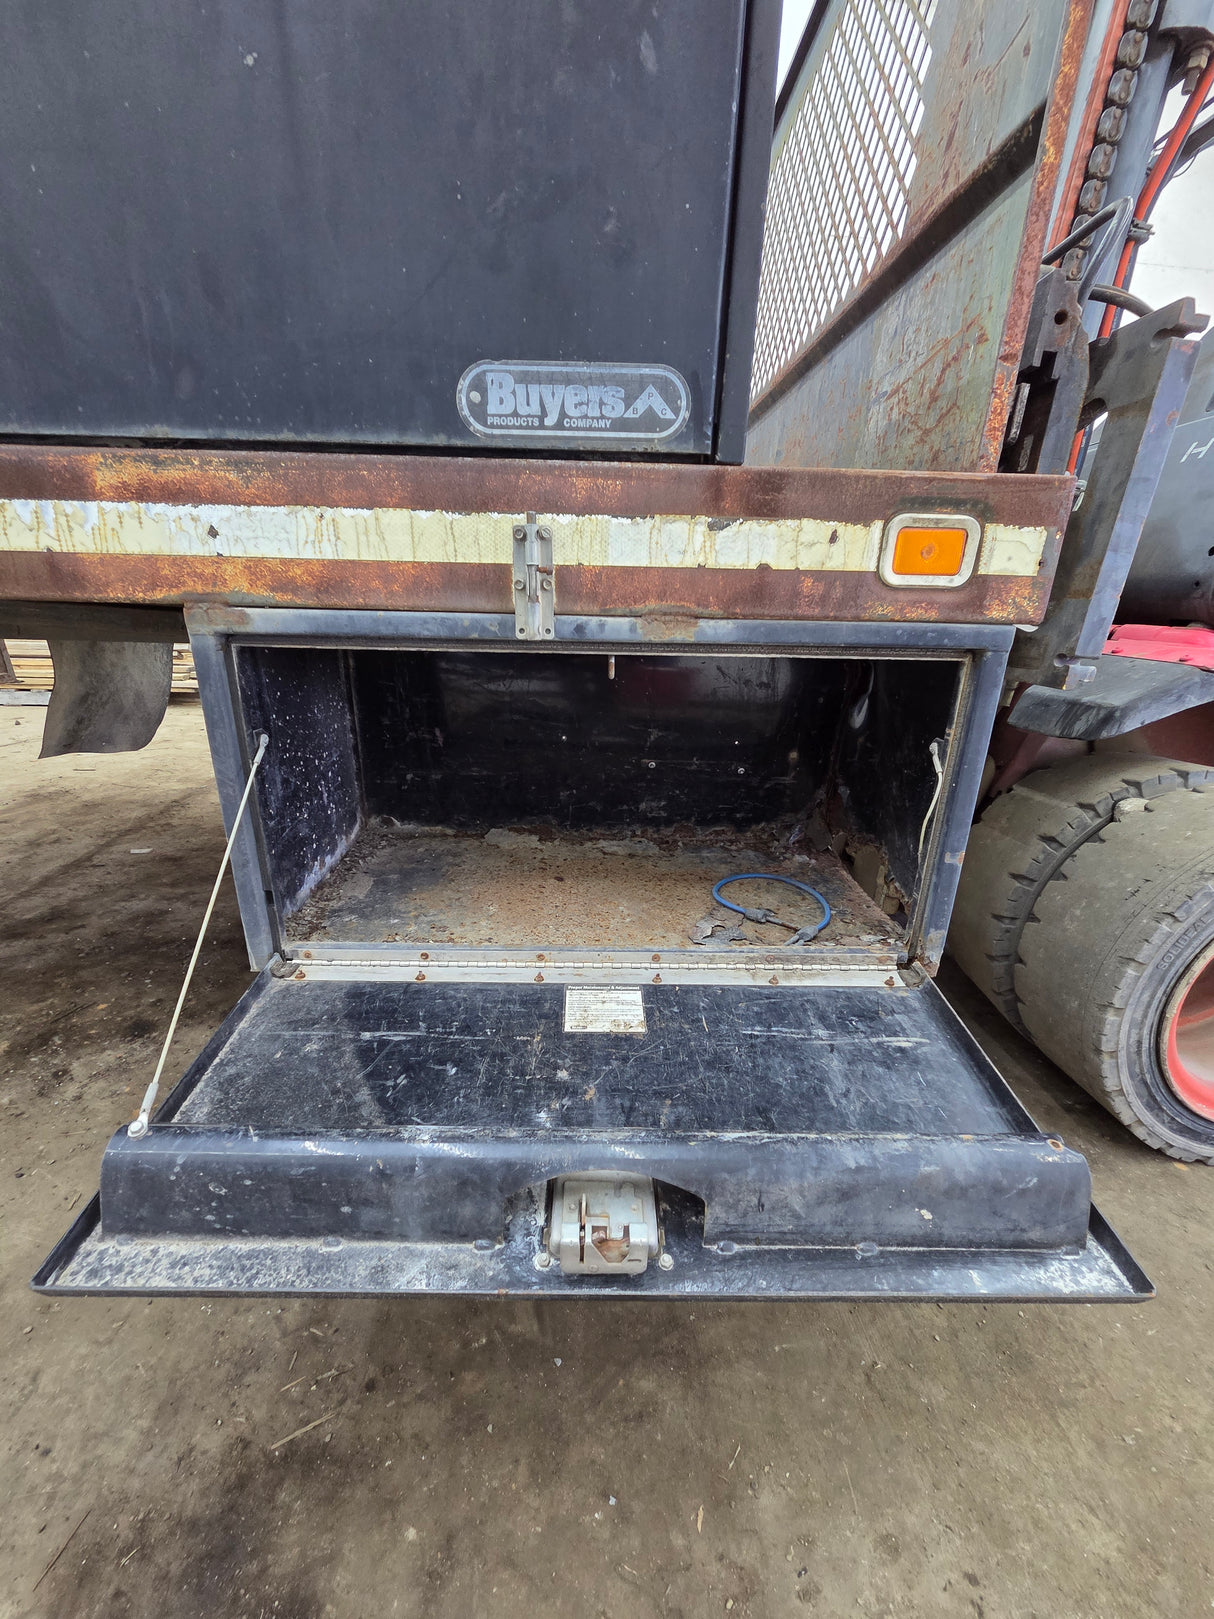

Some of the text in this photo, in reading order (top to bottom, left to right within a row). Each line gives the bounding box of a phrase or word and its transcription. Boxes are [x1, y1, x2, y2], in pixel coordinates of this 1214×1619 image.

[486, 372, 625, 426] Buyers
[487, 416, 613, 429] PRODUCTS COMPANY
